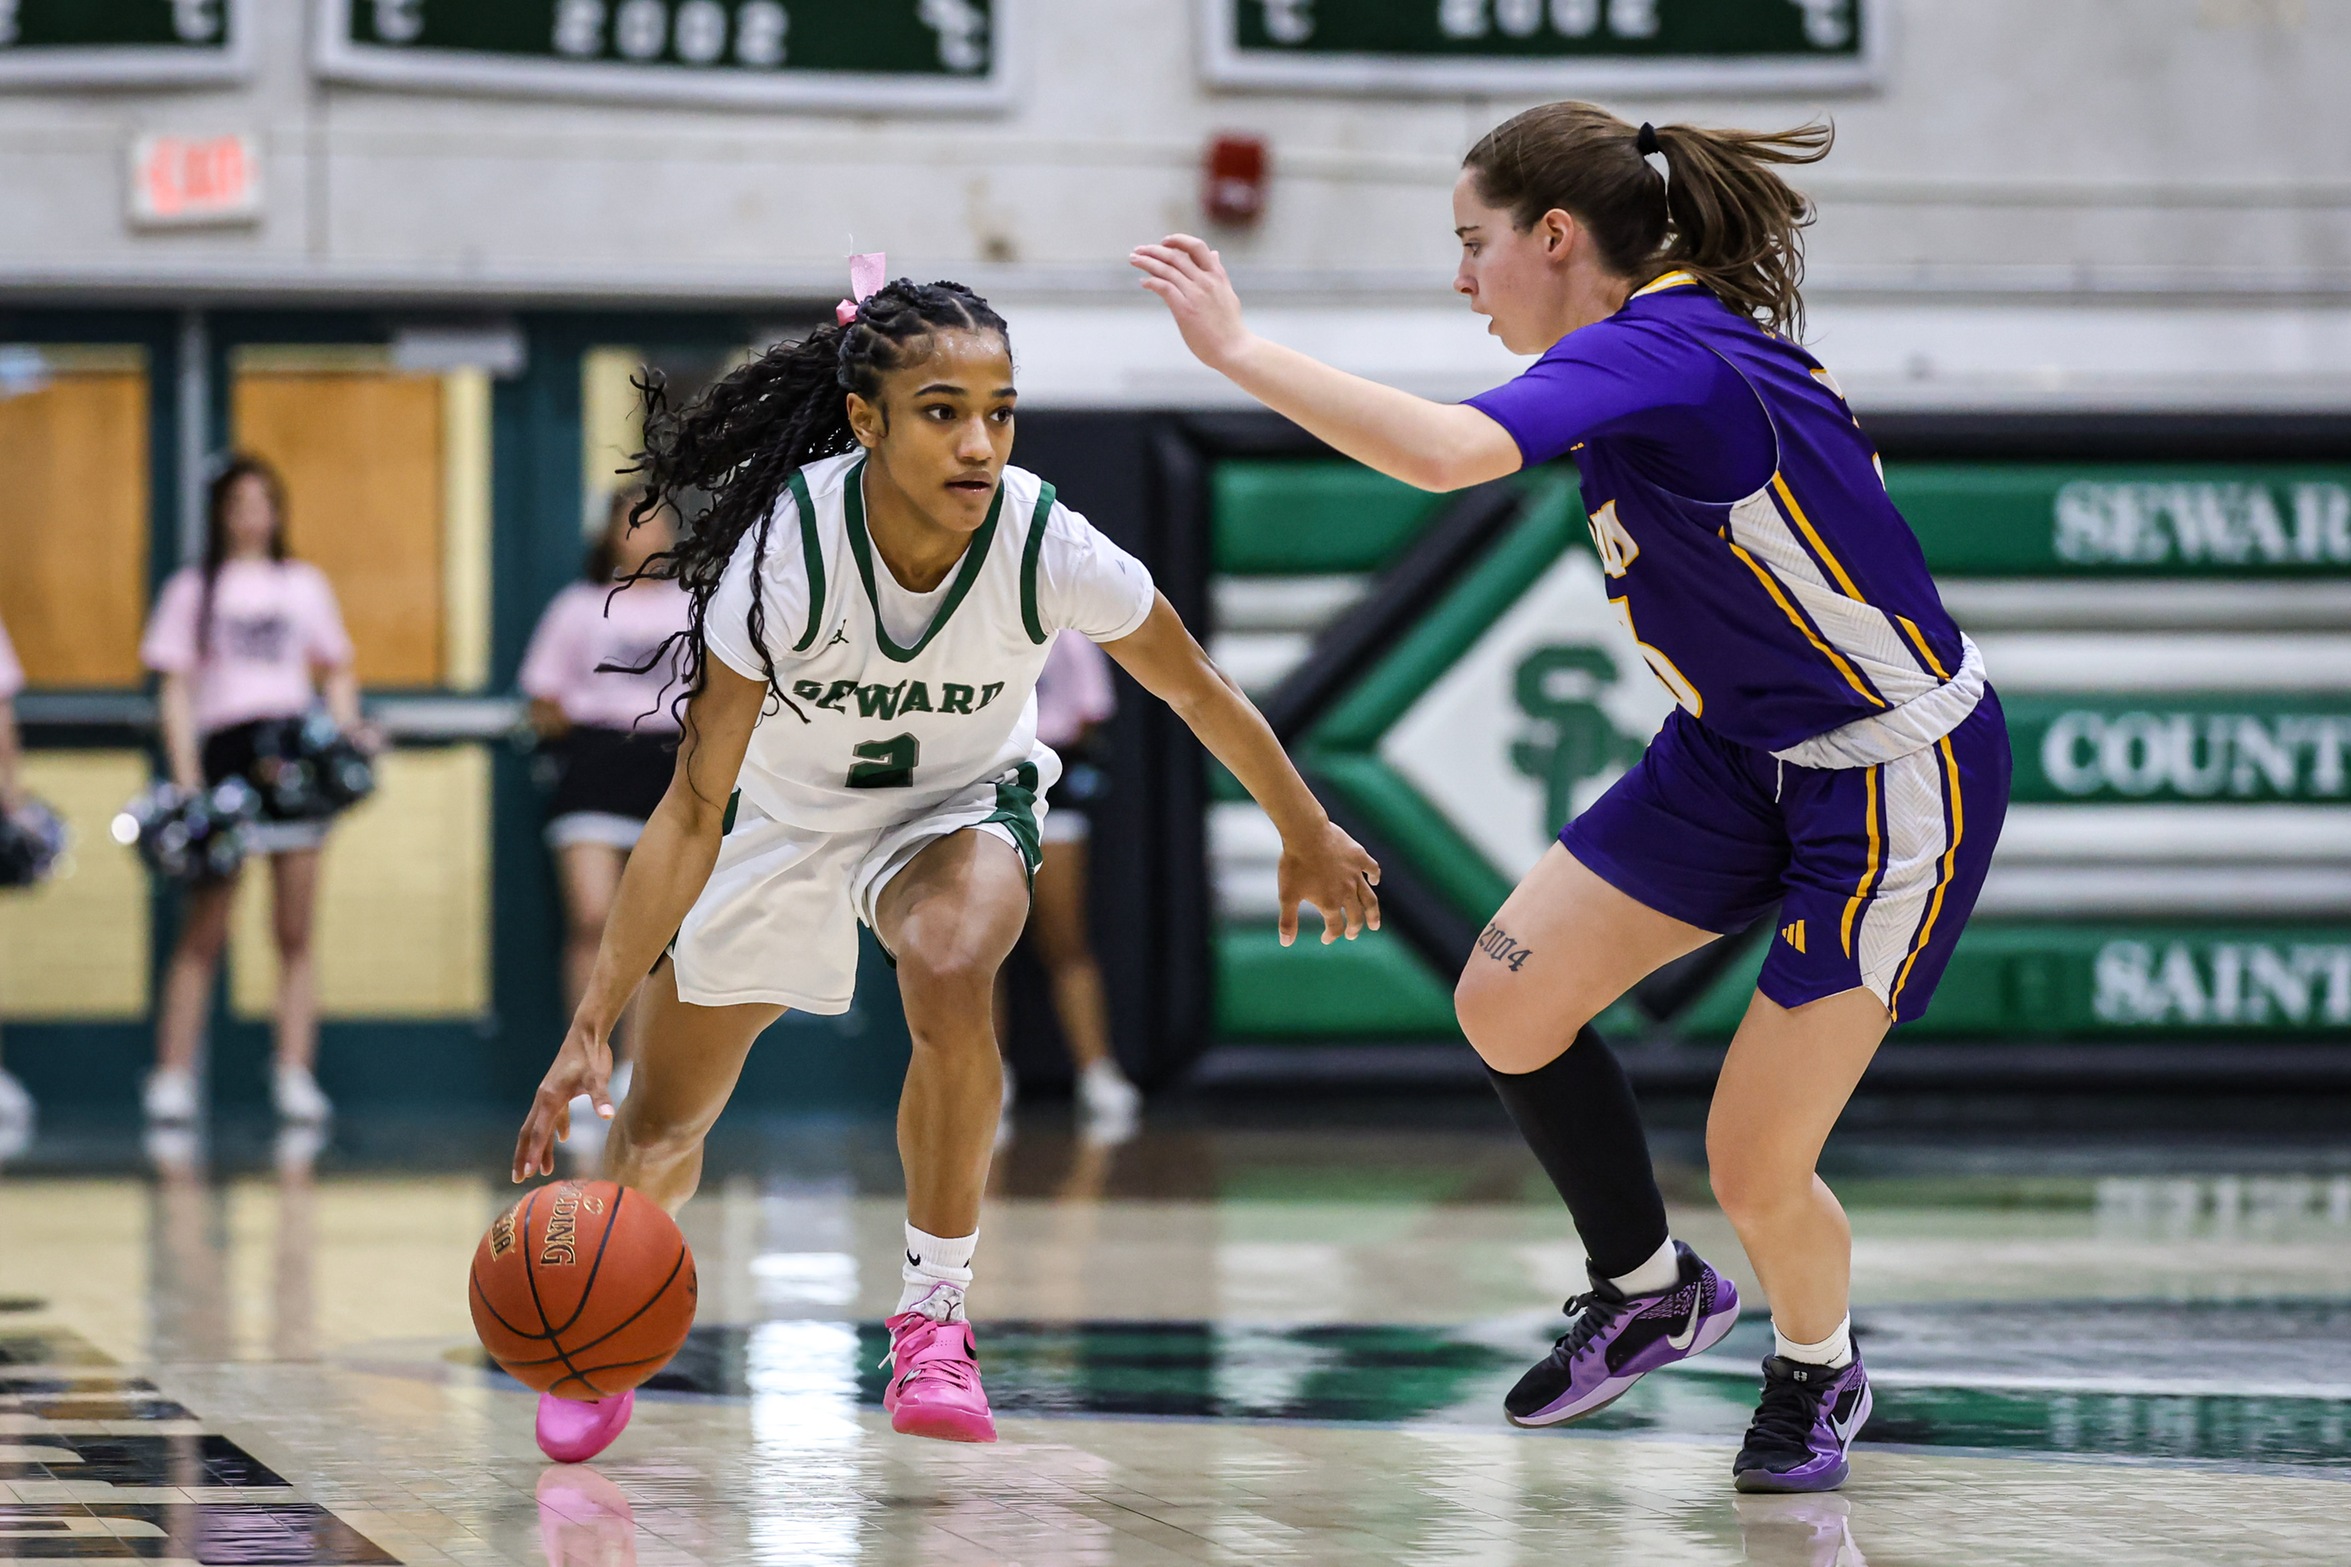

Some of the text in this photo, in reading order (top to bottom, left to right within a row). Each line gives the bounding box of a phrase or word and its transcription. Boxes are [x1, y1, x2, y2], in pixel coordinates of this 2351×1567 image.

[792, 679, 1005, 720] SEWARD
[845, 732, 920, 787] 2
[2041, 710, 2351, 794] COUNT
[1478, 922, 1533, 972] 2004
